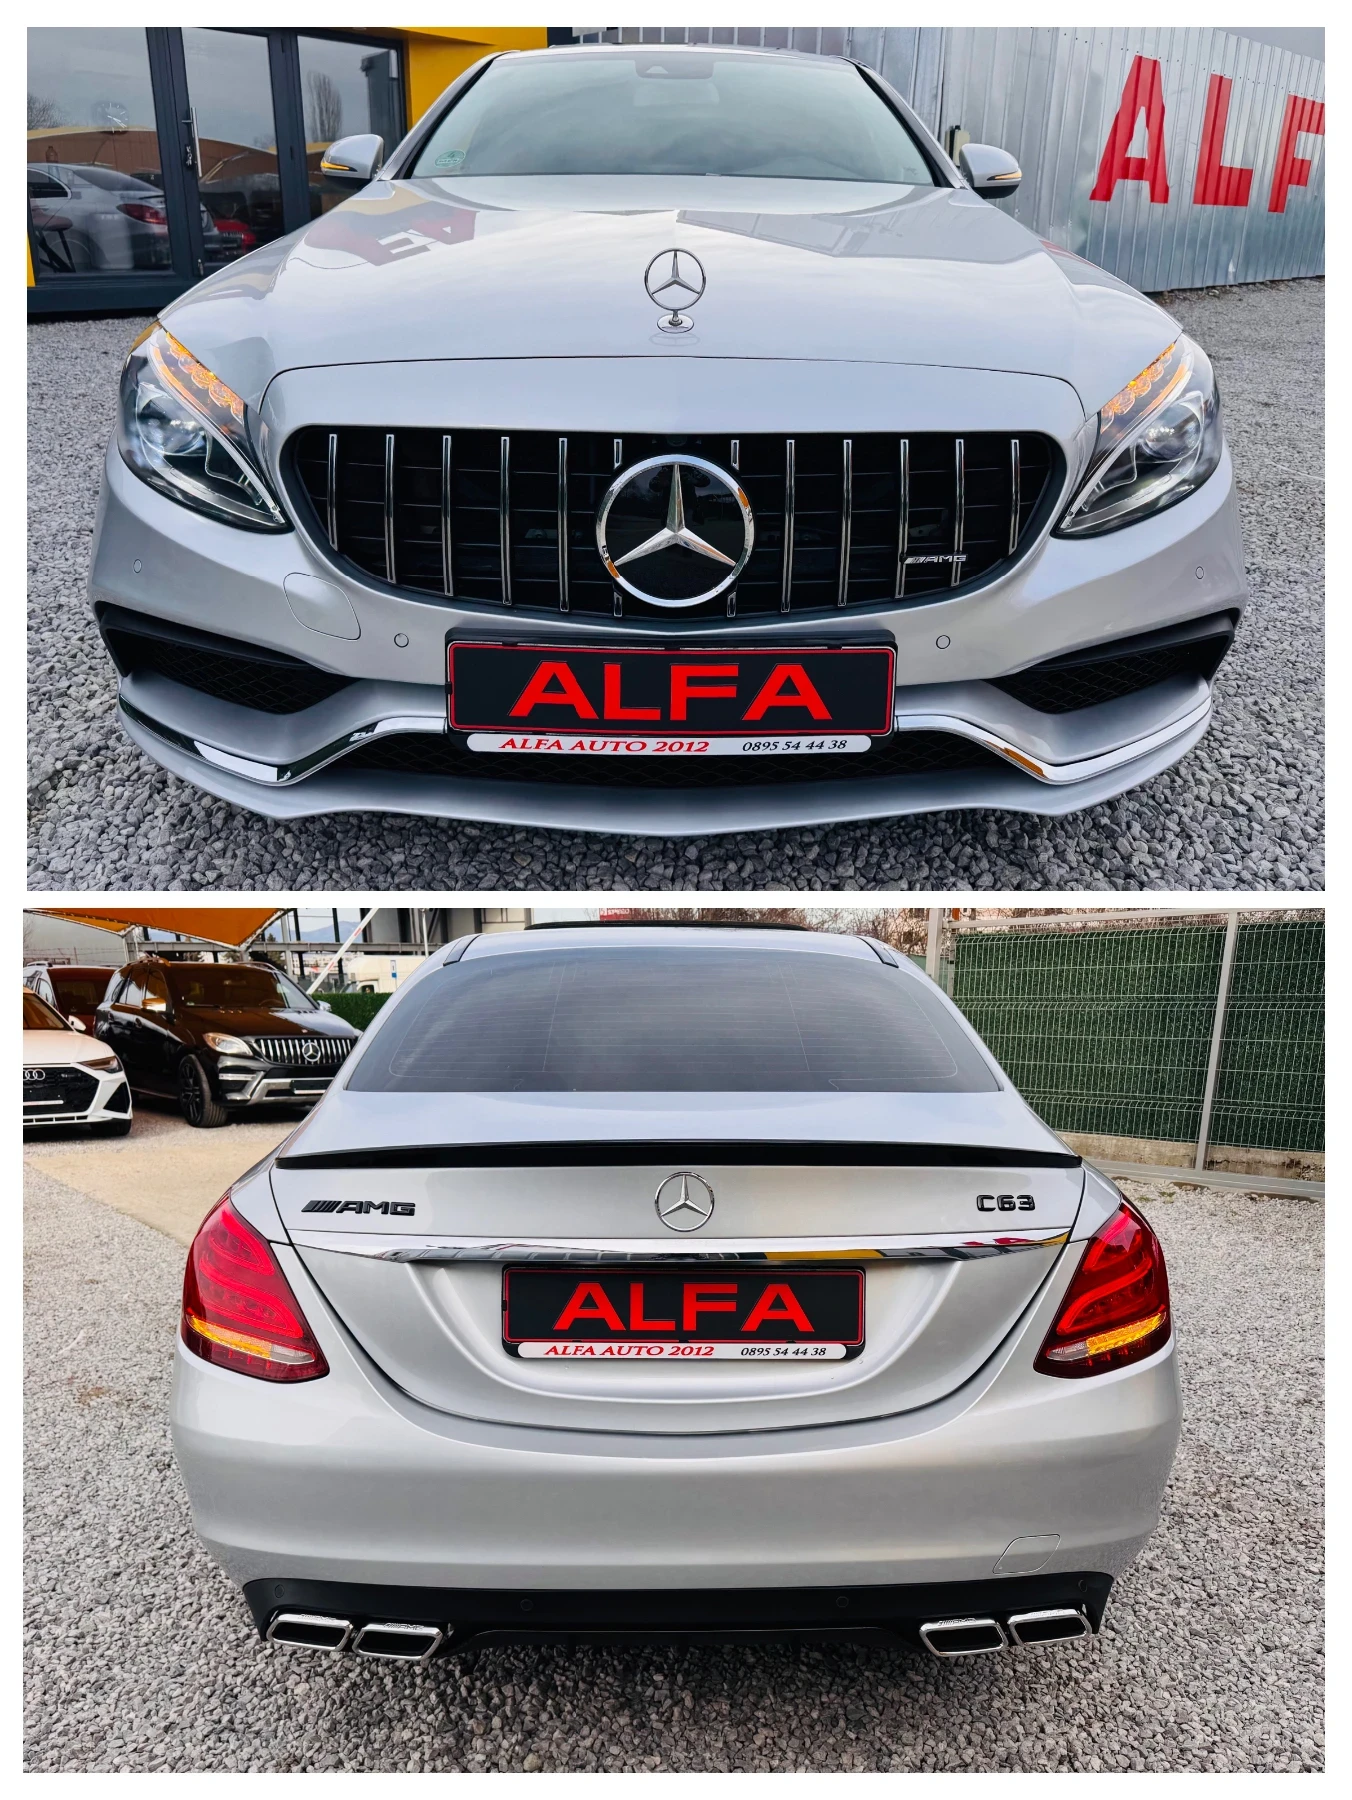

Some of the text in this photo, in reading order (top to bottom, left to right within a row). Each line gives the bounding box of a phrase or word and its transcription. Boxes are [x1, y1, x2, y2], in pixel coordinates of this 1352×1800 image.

[508, 660, 833, 721] ALFA
[499, 737, 848, 753] ALFA AUTO 2012 0895 54 44 38
[335, 1200, 416, 1217] AMG
[976, 1194, 1036, 1212] C63
[552, 1282, 816, 1332] ALFA
[543, 1345, 827, 1356] ALFA AUTO 2012 0895 54 44 38
